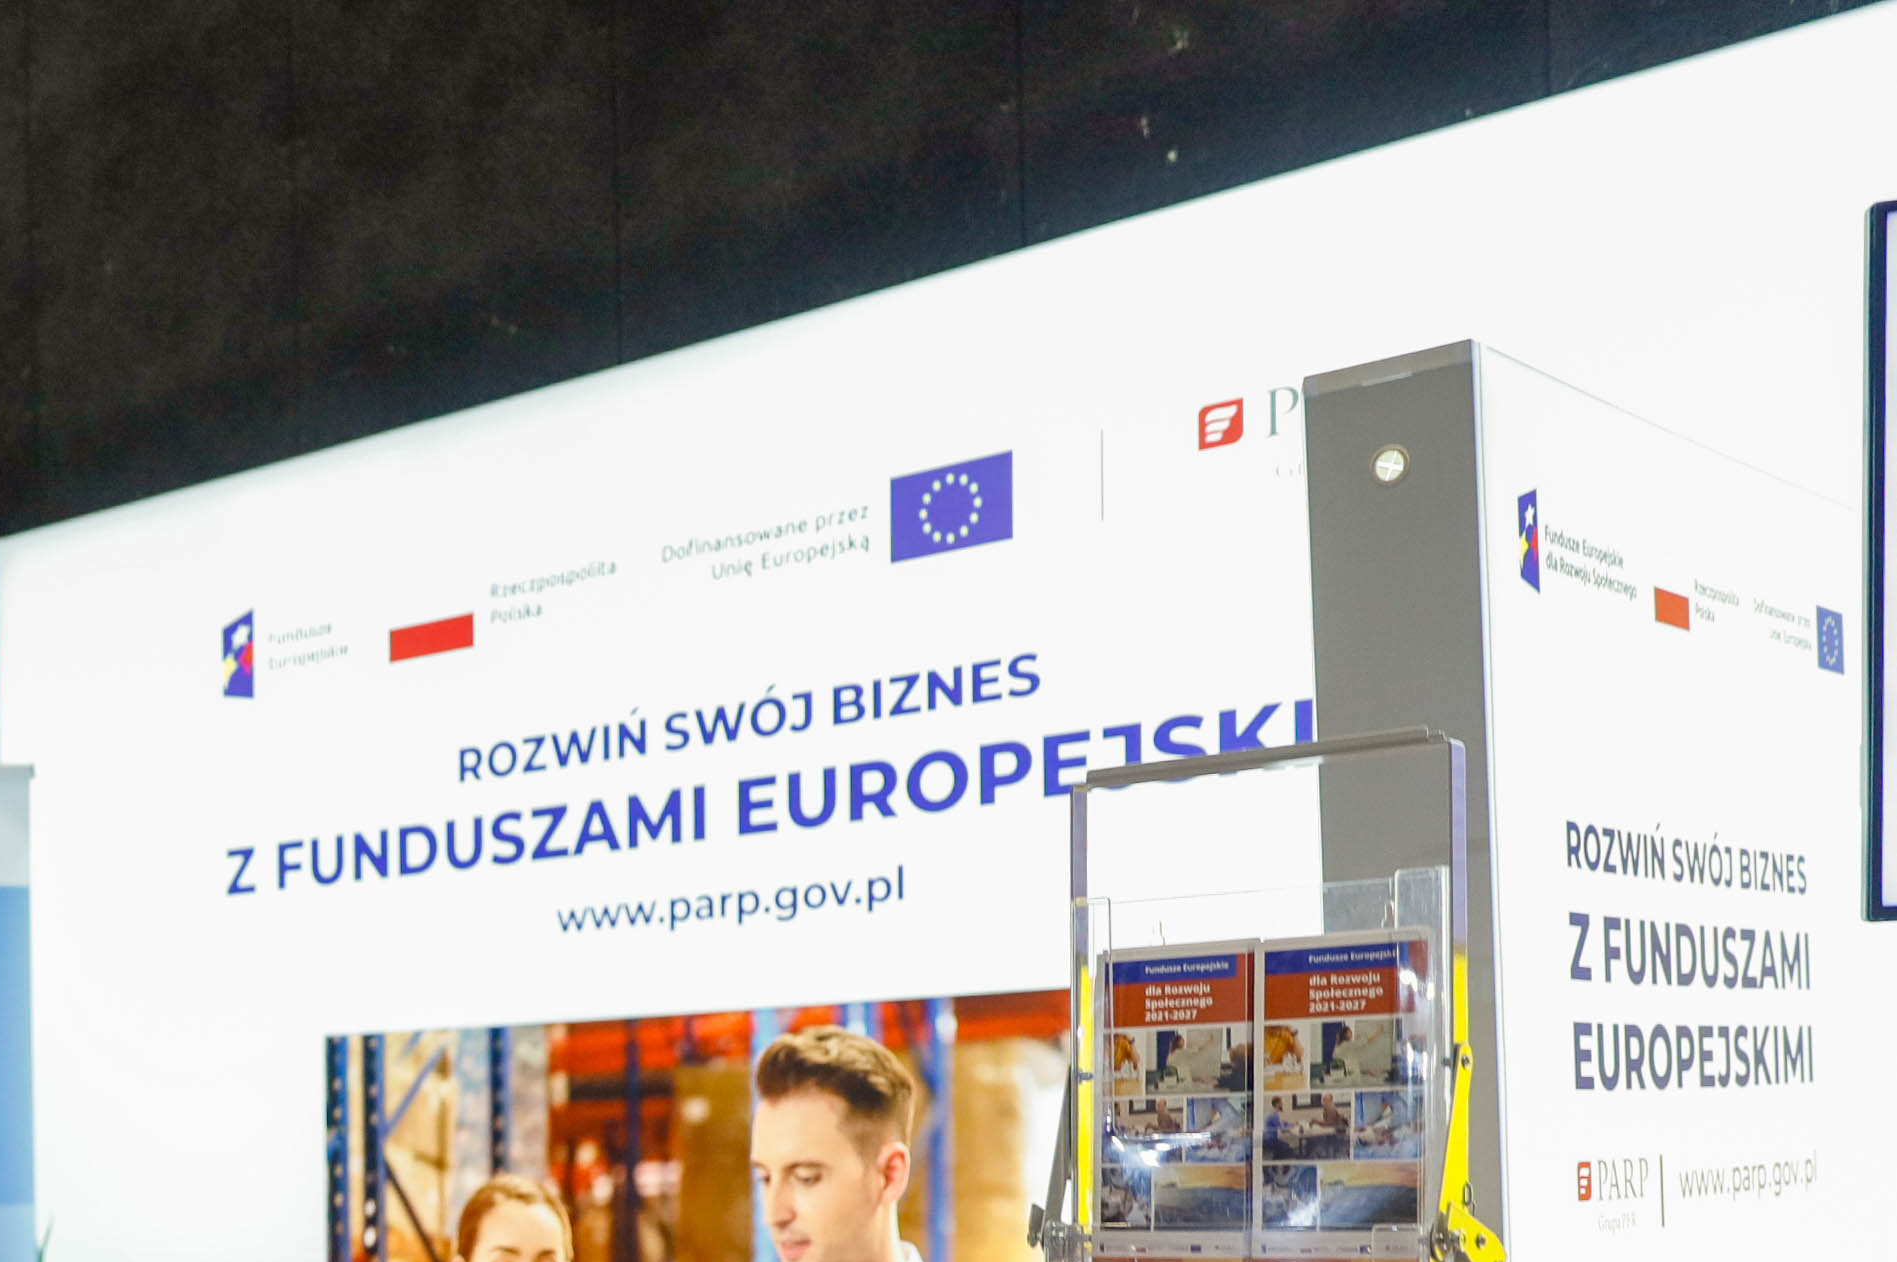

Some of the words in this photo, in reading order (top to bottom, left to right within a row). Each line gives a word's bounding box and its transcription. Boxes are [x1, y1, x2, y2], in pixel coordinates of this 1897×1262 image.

[661, 518, 808, 564] Dofinansowane
[815, 504, 869, 533] przez
[711, 557, 753, 581] Unię
[761, 532, 870, 571] Europejską
[457, 706, 648, 784] ROZWIŃ
[664, 684, 813, 751] SWÓJ
[832, 651, 1041, 727] BIZNES
[226, 847, 256, 896] Z
[277, 783, 706, 890] FUNDUSZAMI
[737, 697, 1315, 836] EUROPEJSKI
[1565, 820, 1666, 881] ROZWIŃ
[1672, 832, 1733, 888] SWÓJ
[1740, 845, 1807, 896] BIZNES
[557, 864, 905, 932] www.parp.gov.pl
[1569, 911, 1592, 982] Z
[1604, 915, 1811, 991] FUNDUSZAMI
[1145, 984, 1162, 997] dla
[1164, 981, 1211, 996] Rozwoju
[1145, 996, 1214, 1011] Społecznego
[1309, 974, 1327, 987] dla
[1330, 970, 1381, 986] Rozwoju
[1309, 986, 1384, 1002] Społecznego
[1145, 1008, 1198, 1023] 2021-2027
[1309, 999, 1367, 1014] 2021-2027
[1573, 1021, 1814, 1091] EUROPEJSKIMI
[1597, 1157, 1649, 1201] PARP
[1679, 1149, 1817, 1202] www.parp.gov.pl
